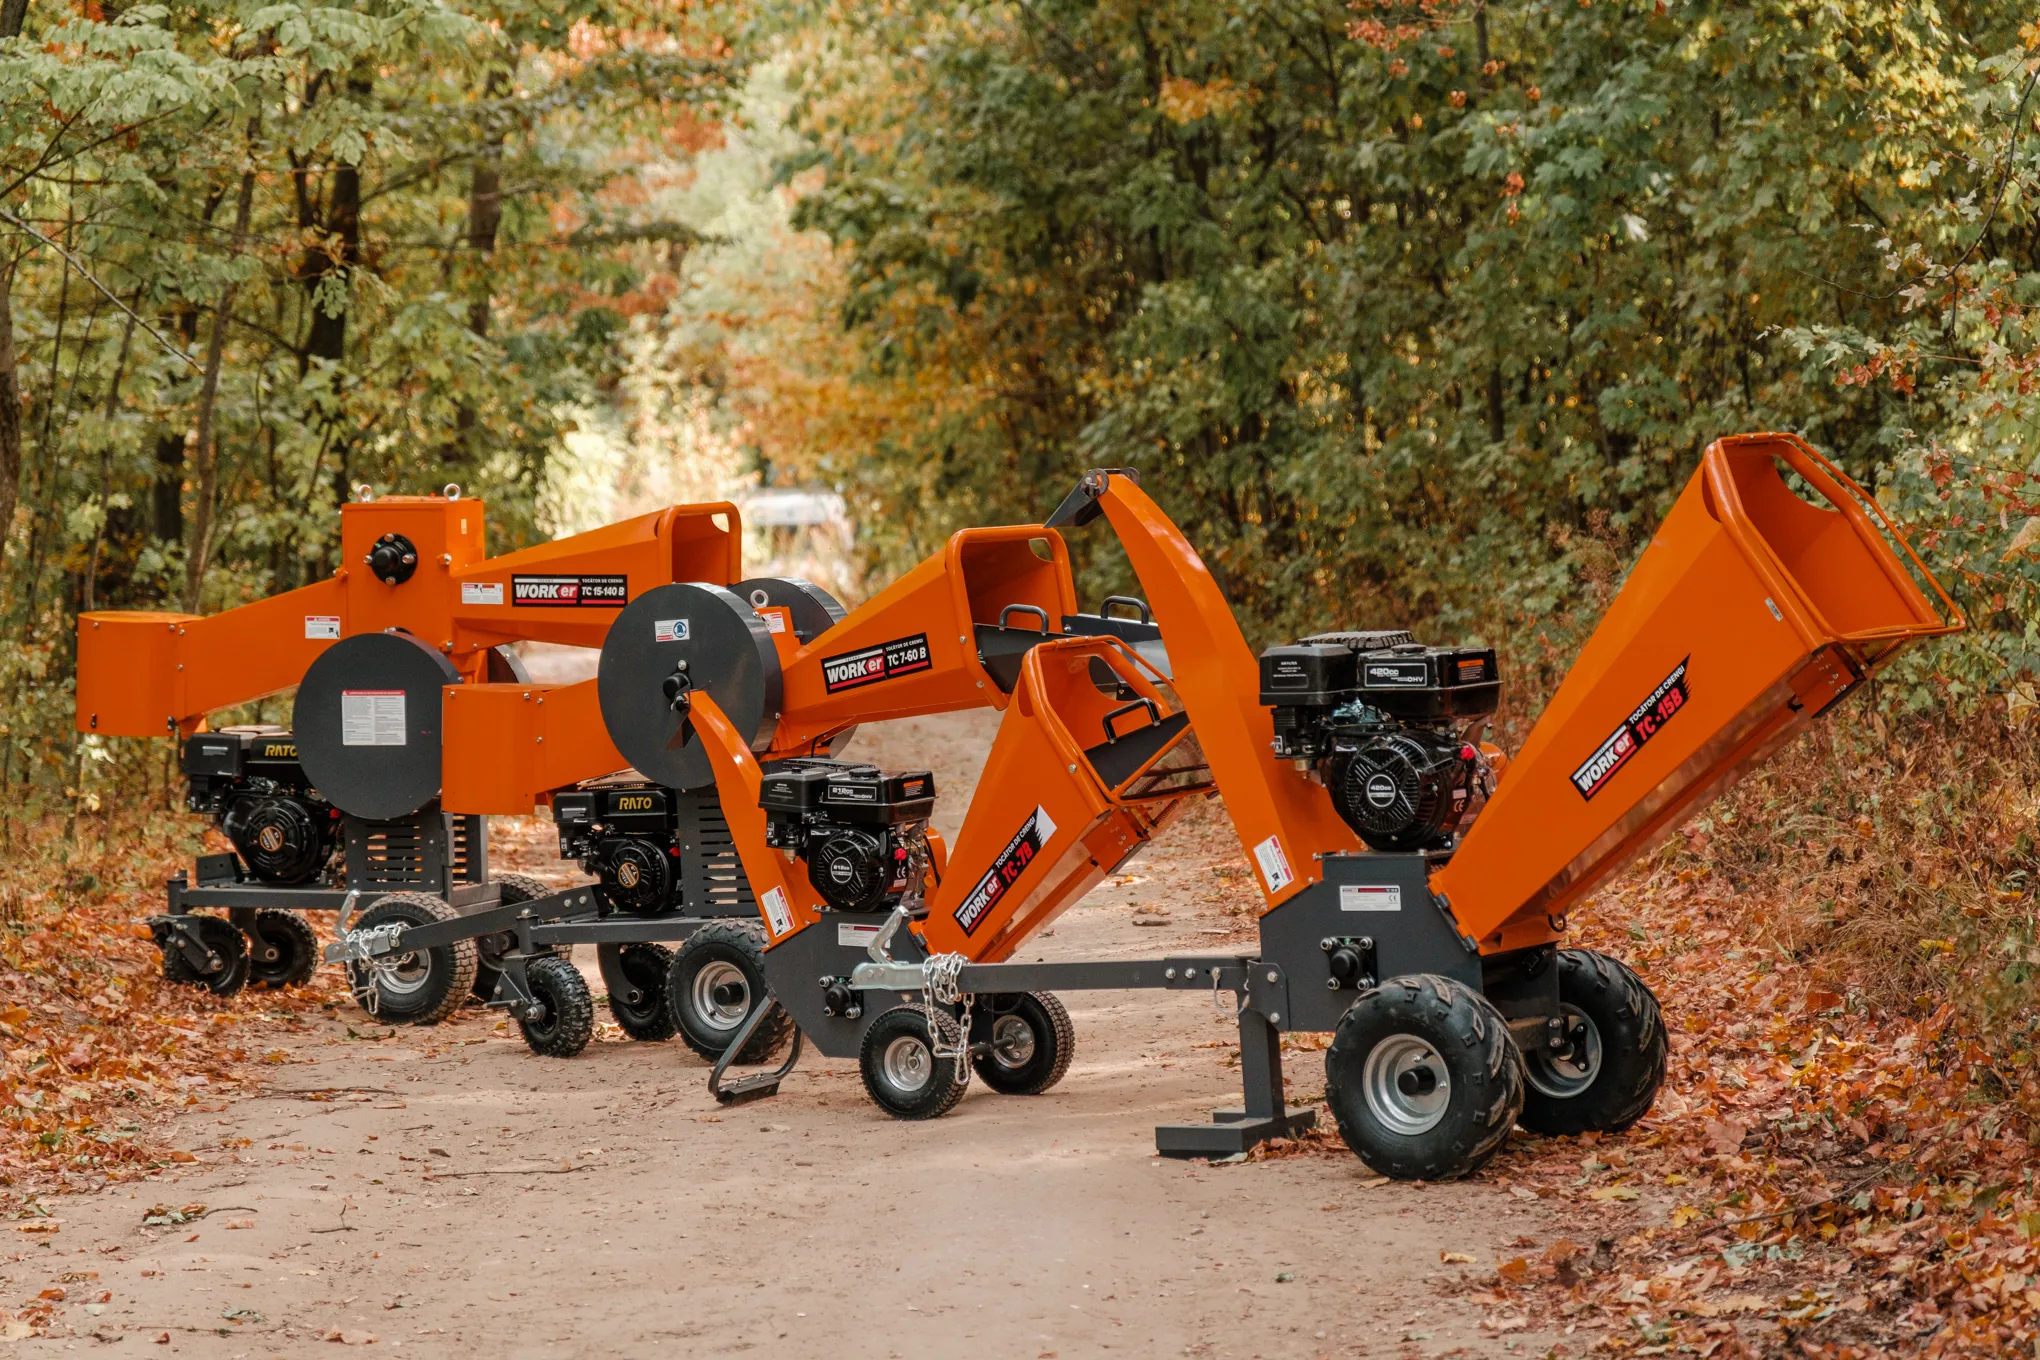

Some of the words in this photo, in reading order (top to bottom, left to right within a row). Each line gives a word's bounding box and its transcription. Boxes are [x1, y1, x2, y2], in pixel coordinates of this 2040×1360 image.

[582, 587, 592, 595] TC
[593, 586, 617, 596] 15-140
[619, 587, 624, 595] B
[888, 654, 898, 667] TC
[900, 650, 918, 663] 7-60
[920, 647, 926, 658] B
[1654, 686, 1664, 698] DE
[1663, 665, 1685, 690] CRENGI
[619, 797, 652, 810] RATO
[1013, 835, 1020, 845] DE
[1019, 817, 1036, 837] CRENGI
[897, 867, 906, 878] CE
